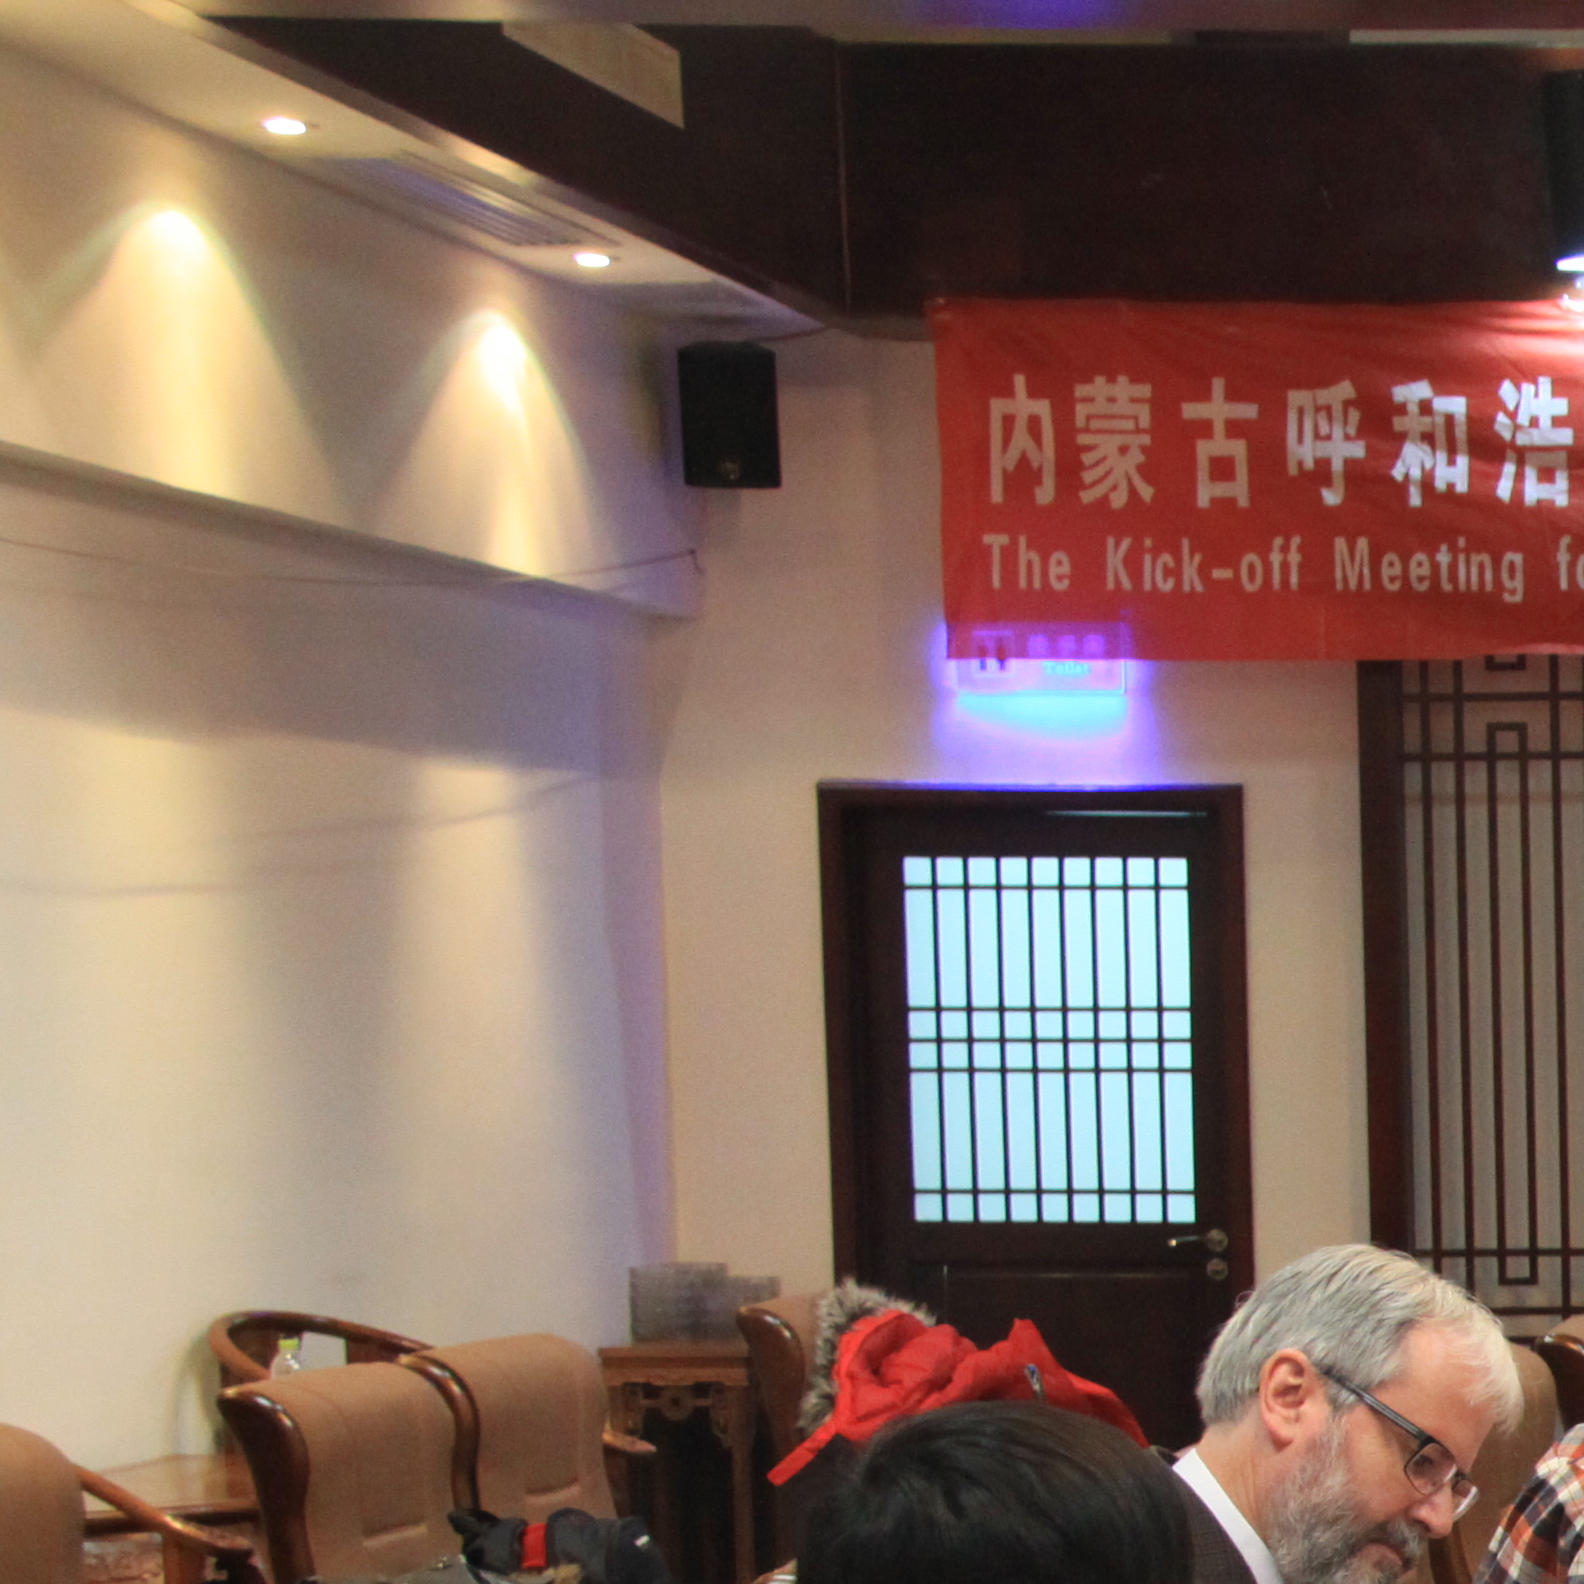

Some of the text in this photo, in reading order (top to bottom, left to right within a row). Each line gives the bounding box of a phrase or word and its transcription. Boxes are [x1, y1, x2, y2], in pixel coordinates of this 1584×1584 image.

[983, 533, 1071, 591] The
[1105, 534, 1302, 594] Kick-off
[1334, 536, 1525, 604] Meeting
